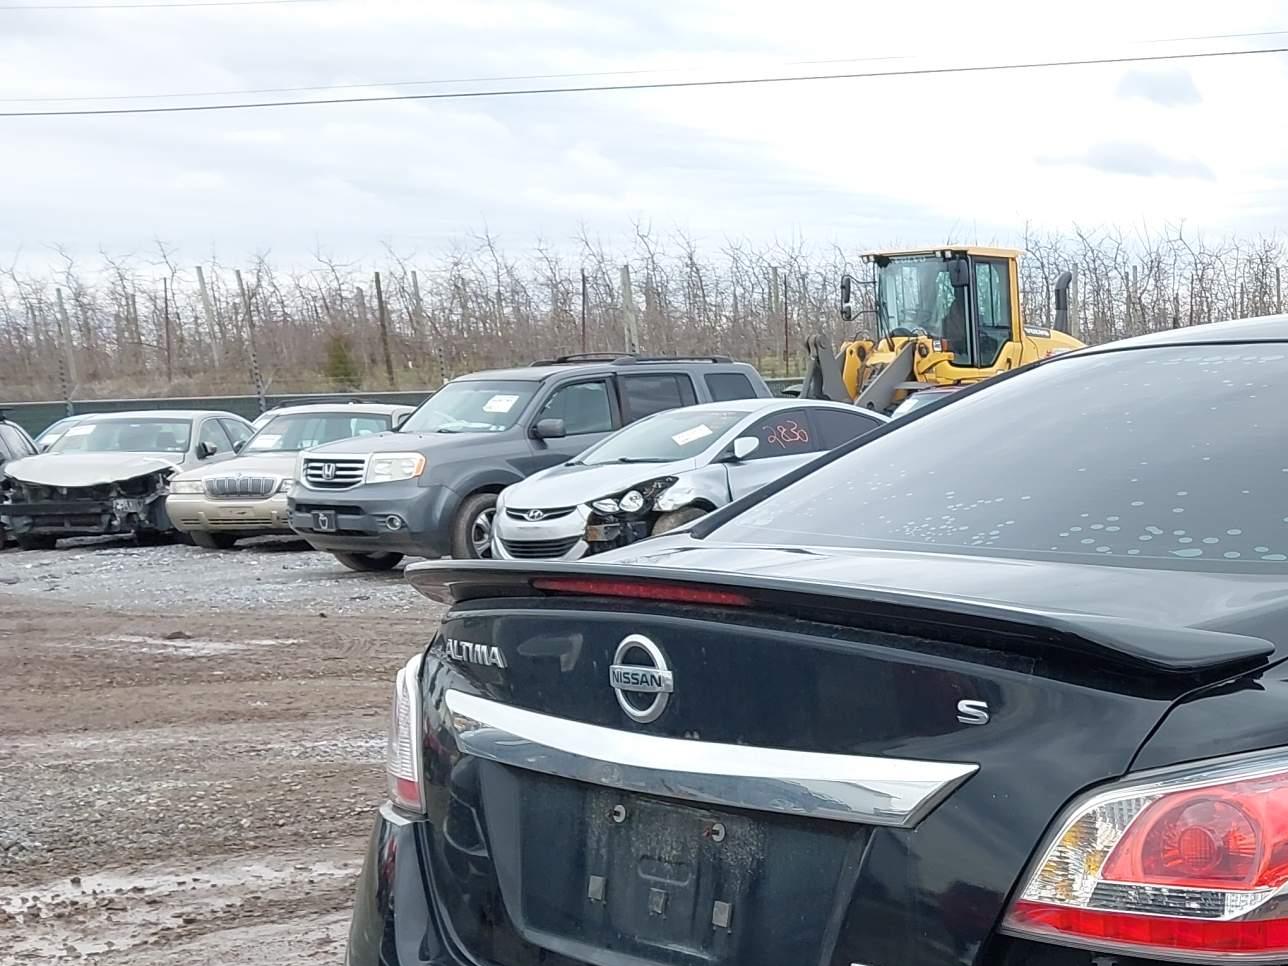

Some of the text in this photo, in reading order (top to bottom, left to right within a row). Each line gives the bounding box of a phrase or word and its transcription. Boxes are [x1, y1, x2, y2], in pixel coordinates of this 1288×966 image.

[762, 420, 808, 448] 2830
[446, 638, 507, 668] ALTIMA
[612, 670, 662, 687] NISSAN
[957, 699, 989, 725] S
